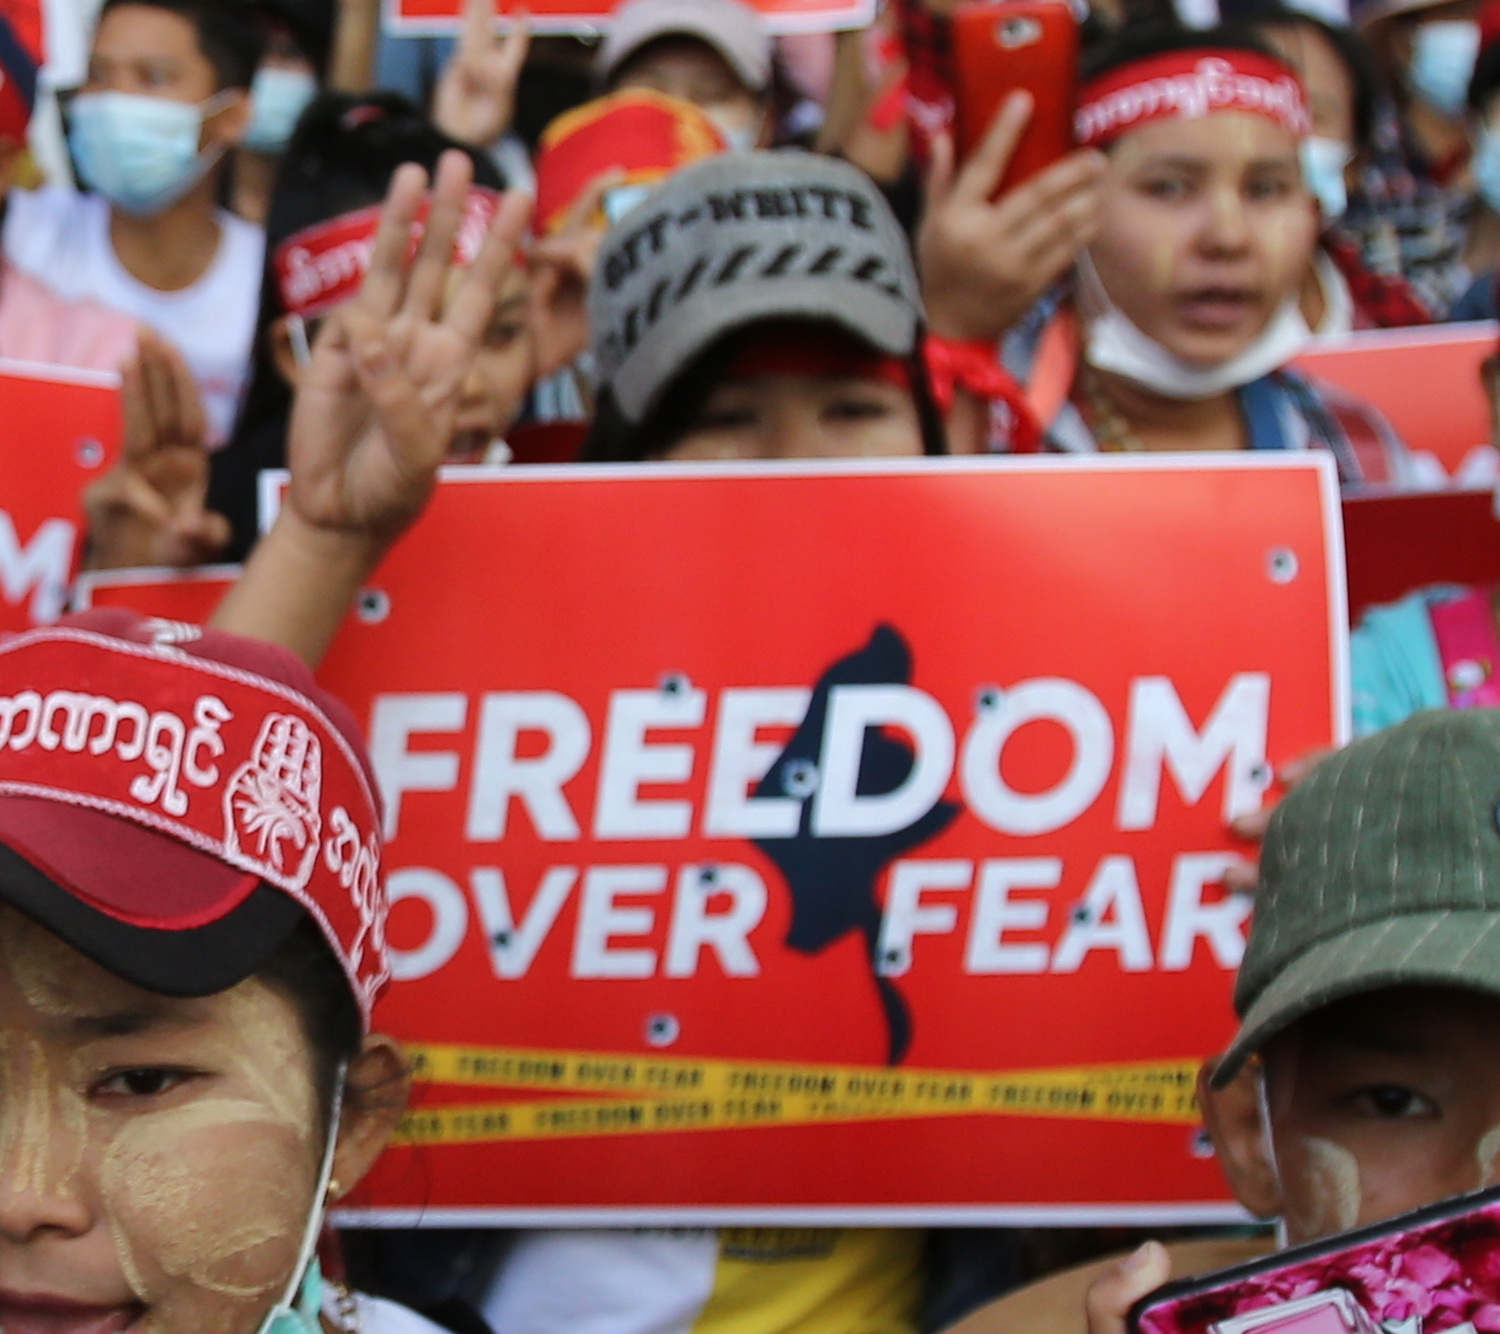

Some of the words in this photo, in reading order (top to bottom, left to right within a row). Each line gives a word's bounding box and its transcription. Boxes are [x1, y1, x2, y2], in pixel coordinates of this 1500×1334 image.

[370, 671, 1271, 843] FREEDOM
[378, 865, 770, 983] OVER
[876, 853, 1249, 978] FEAR
